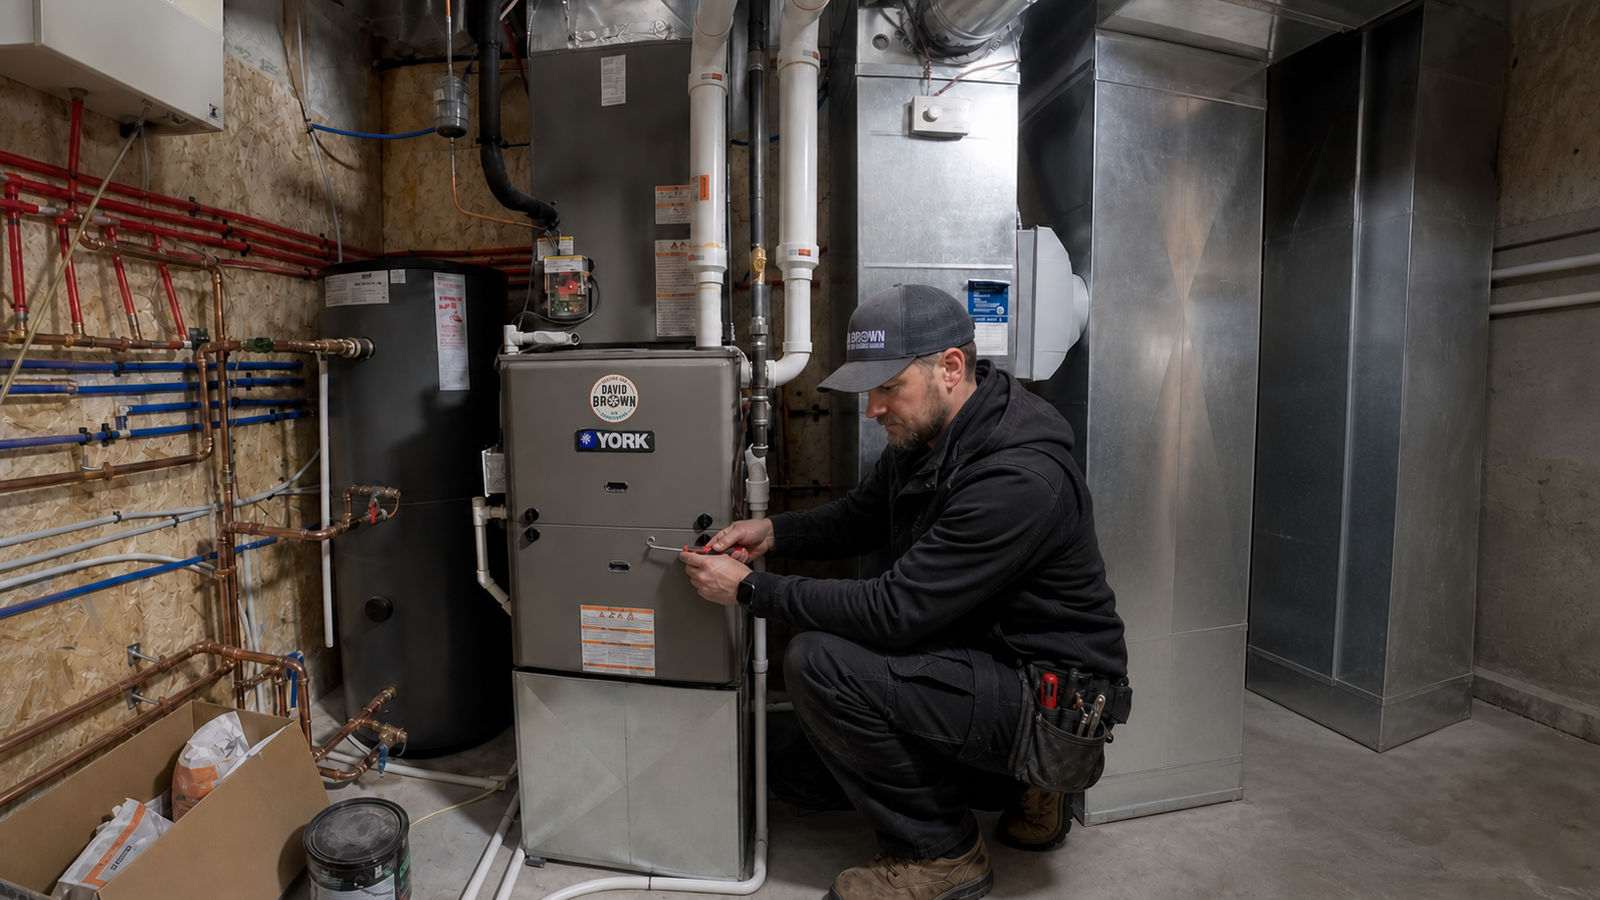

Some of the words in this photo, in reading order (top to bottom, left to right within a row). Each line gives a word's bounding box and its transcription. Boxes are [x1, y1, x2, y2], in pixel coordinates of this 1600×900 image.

[851, 330, 885, 343] BROWN
[602, 385, 627, 394] DAVID
[593, 395, 636, 408] BROWN
[596, 432, 649, 449] YORK
